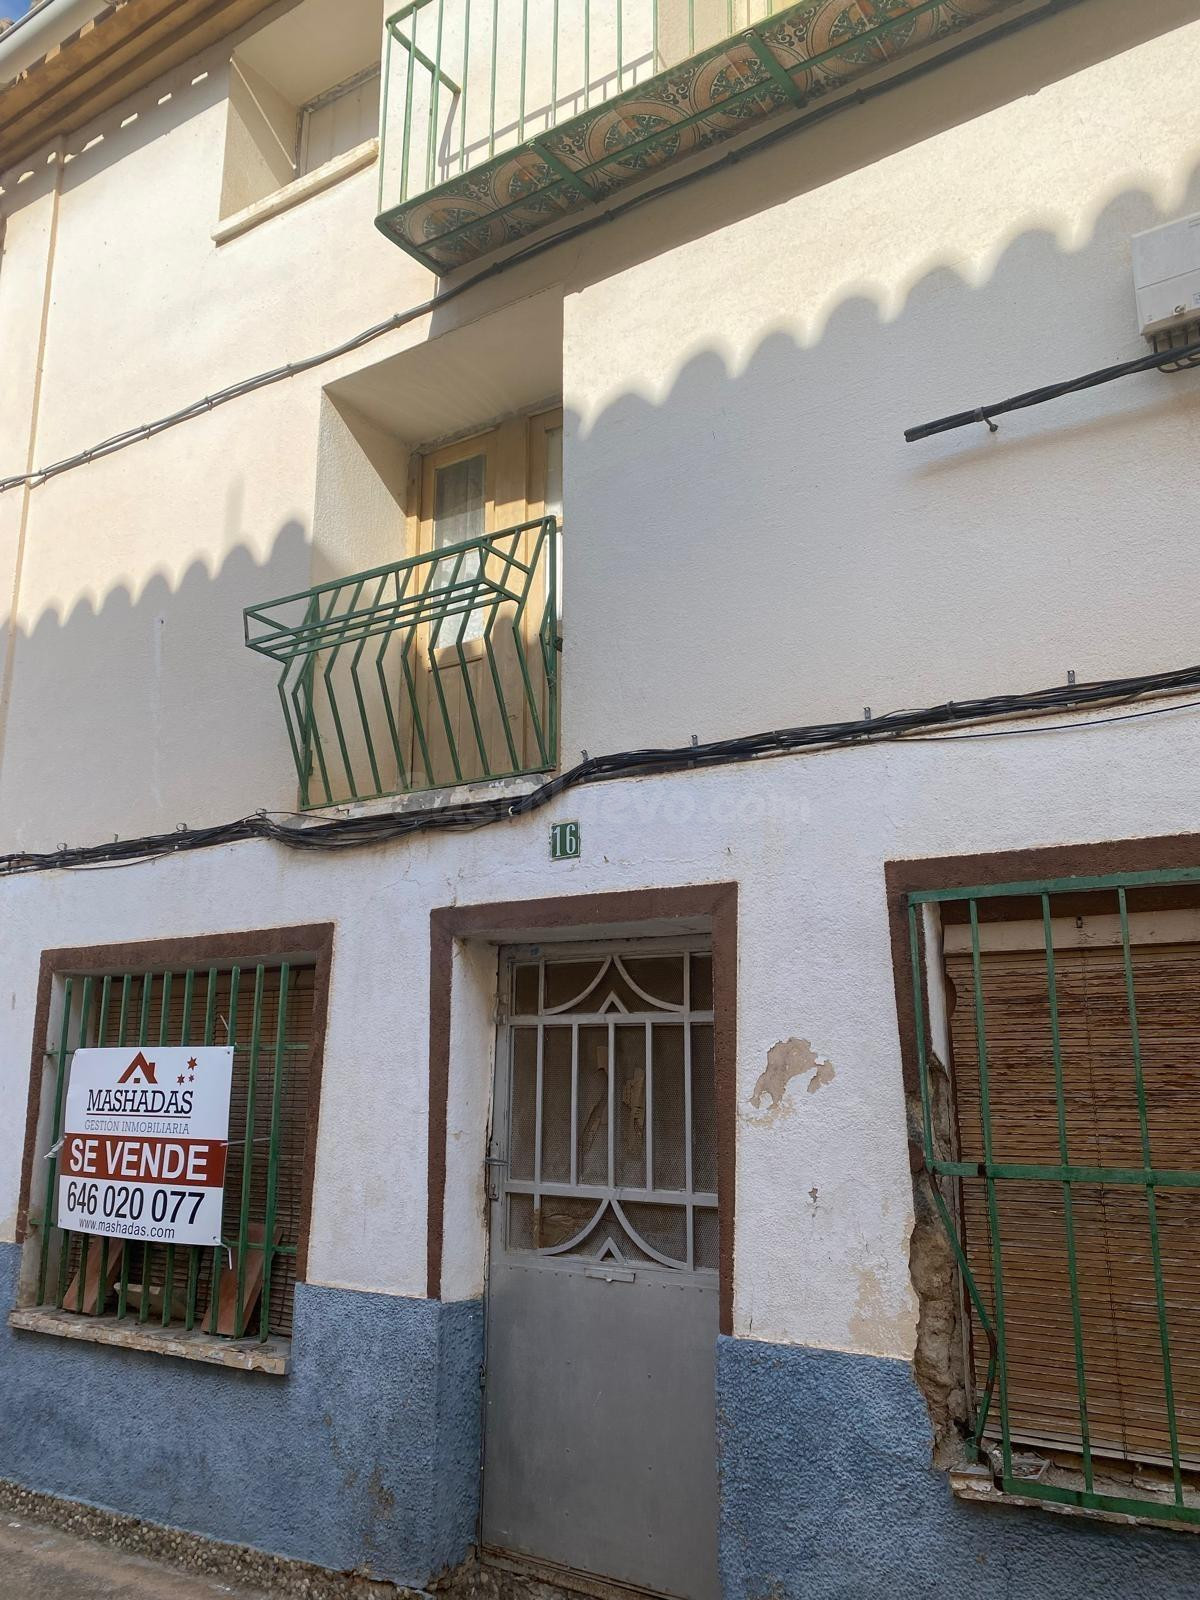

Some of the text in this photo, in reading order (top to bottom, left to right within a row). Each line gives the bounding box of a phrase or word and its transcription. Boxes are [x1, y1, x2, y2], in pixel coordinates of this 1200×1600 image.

[553, 824, 576, 857] 16
[86, 1089, 194, 1115] MASHADAS
[84, 1118, 190, 1135] GESTIÓN INMOBILIARIA
[69, 1138, 209, 1181] SE VENDE
[67, 1181, 206, 1225] 646 020 077
[79, 1217, 175, 1239] www.mashadas.com
